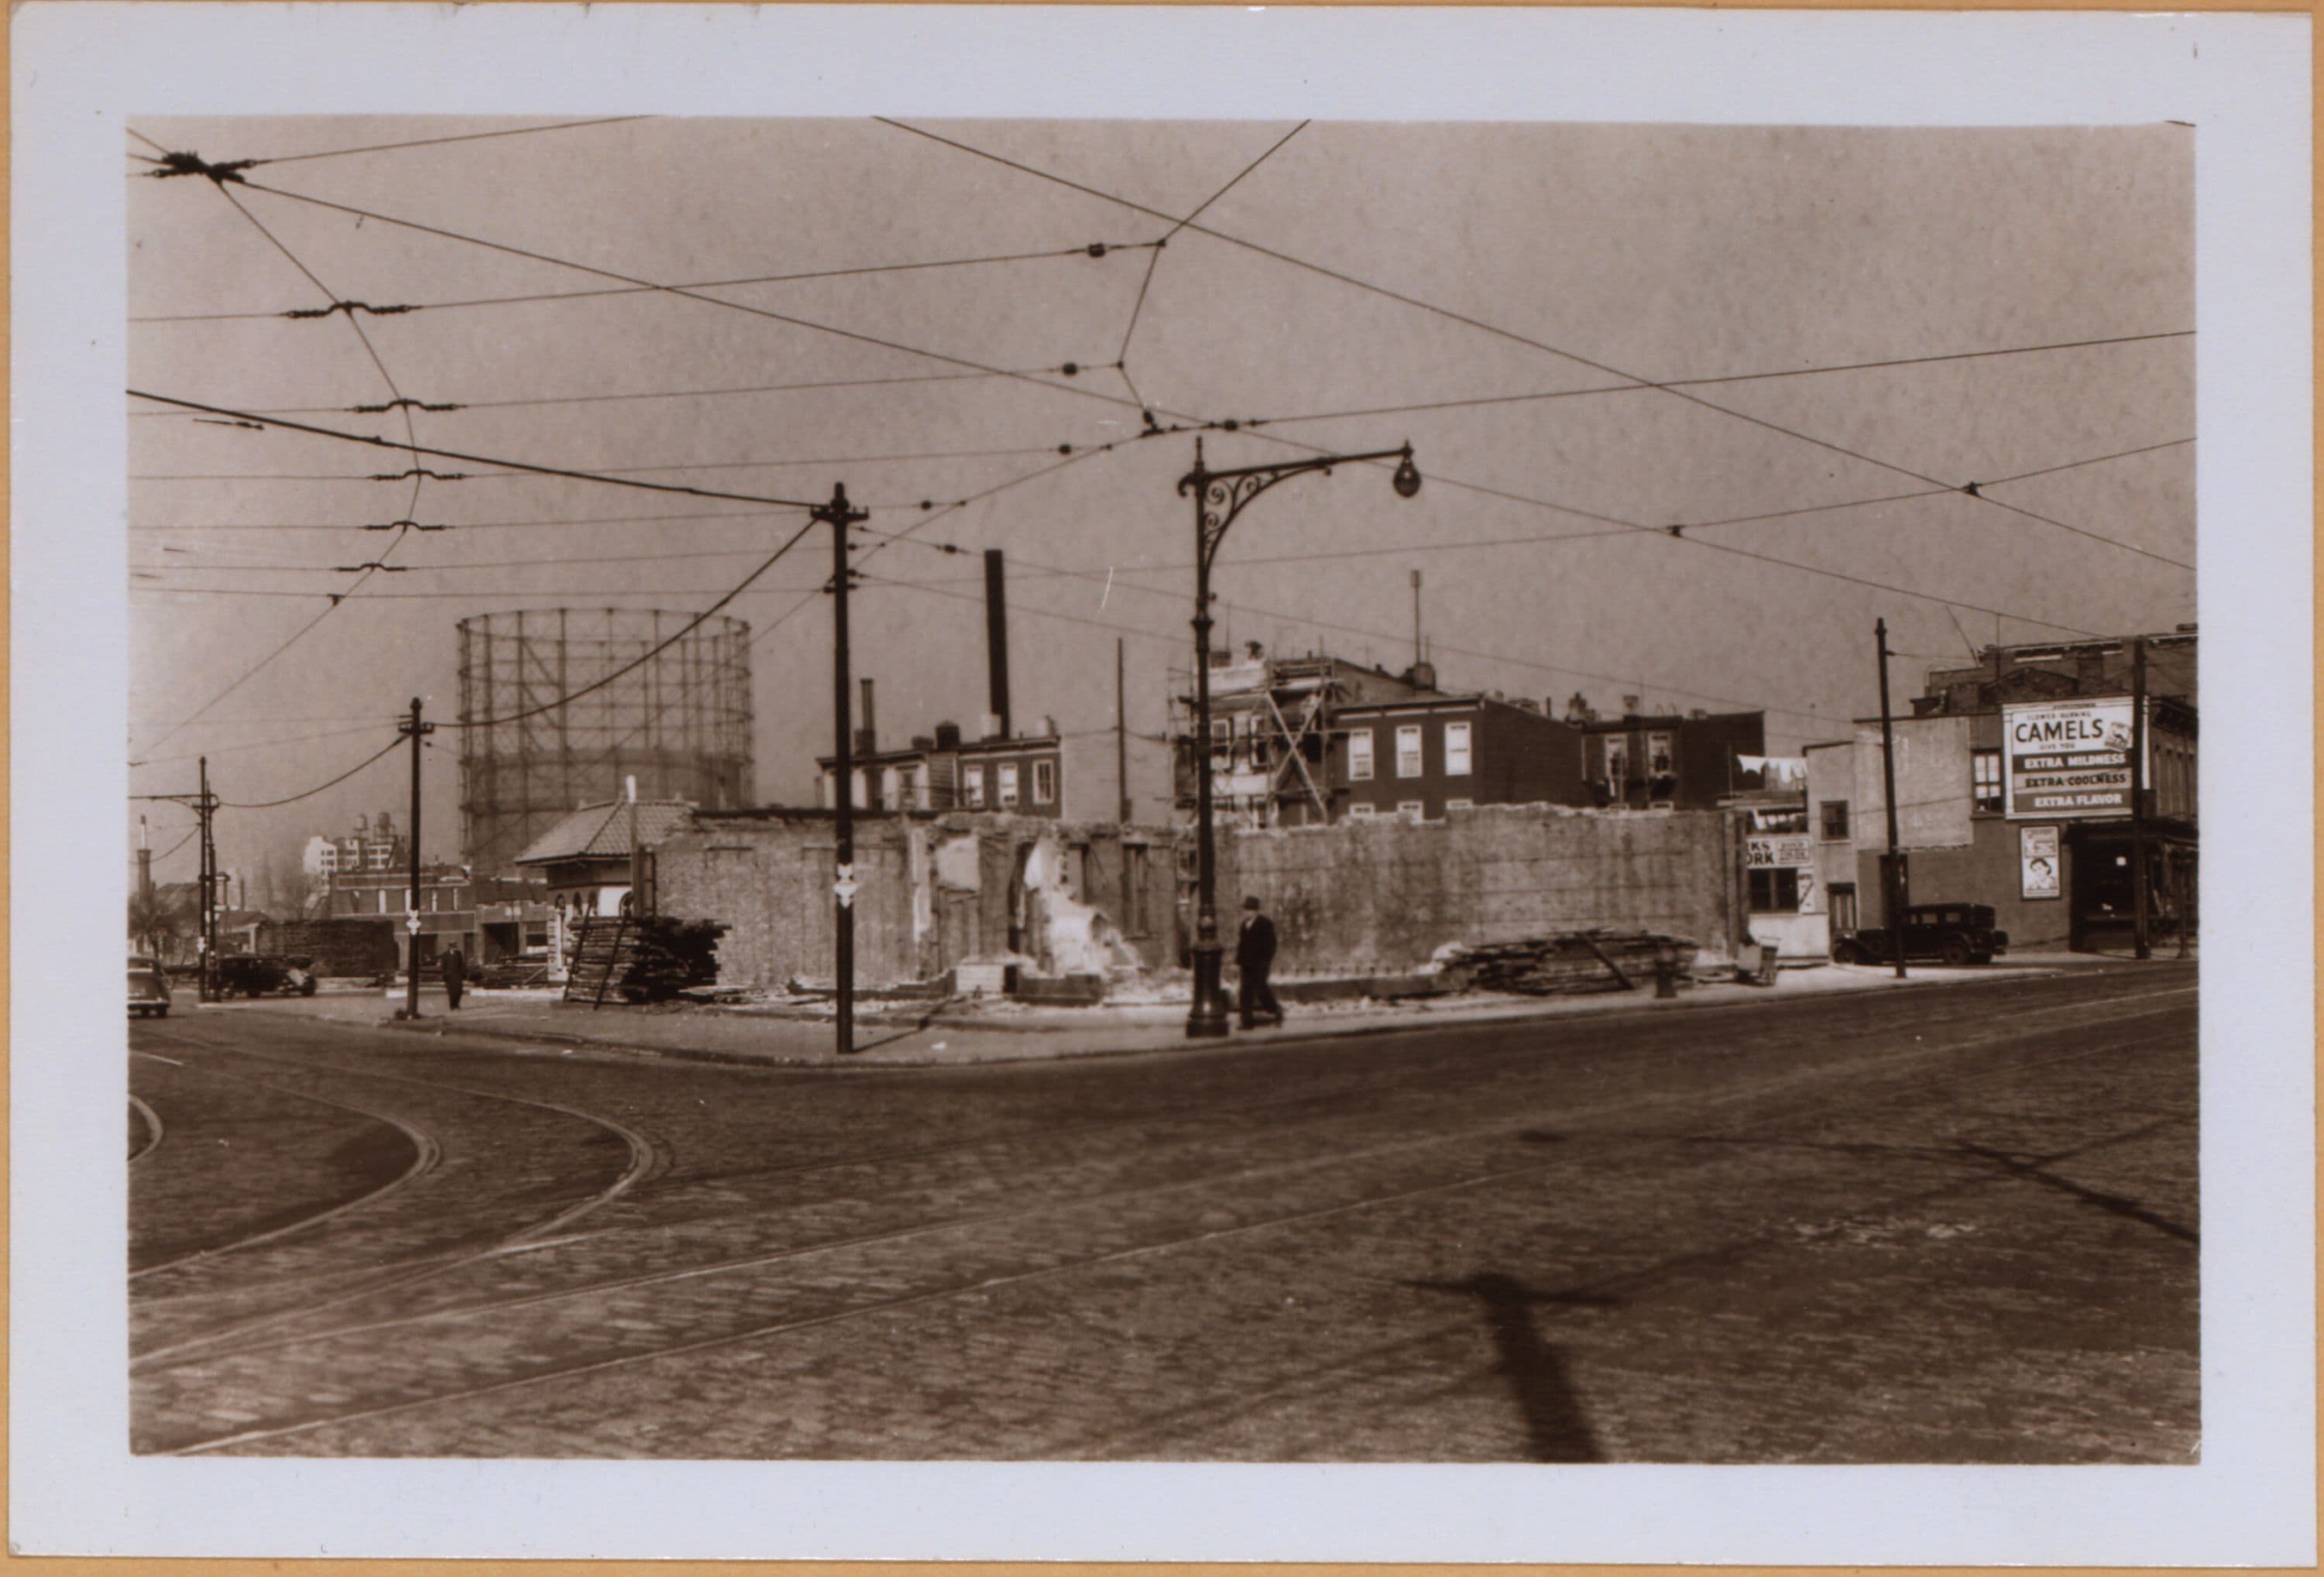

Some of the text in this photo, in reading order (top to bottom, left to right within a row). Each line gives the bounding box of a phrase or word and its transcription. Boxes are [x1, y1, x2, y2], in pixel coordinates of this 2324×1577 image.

[2016, 718, 2103, 742] CAMELS
[2024, 754, 2126, 769] EXTRA MILDNESS
[2026, 773, 2126, 787] EXTRA COOLNESS
[2034, 794, 2123, 807] EXTRA FLAVOR
[1746, 842, 1770, 851] KS
